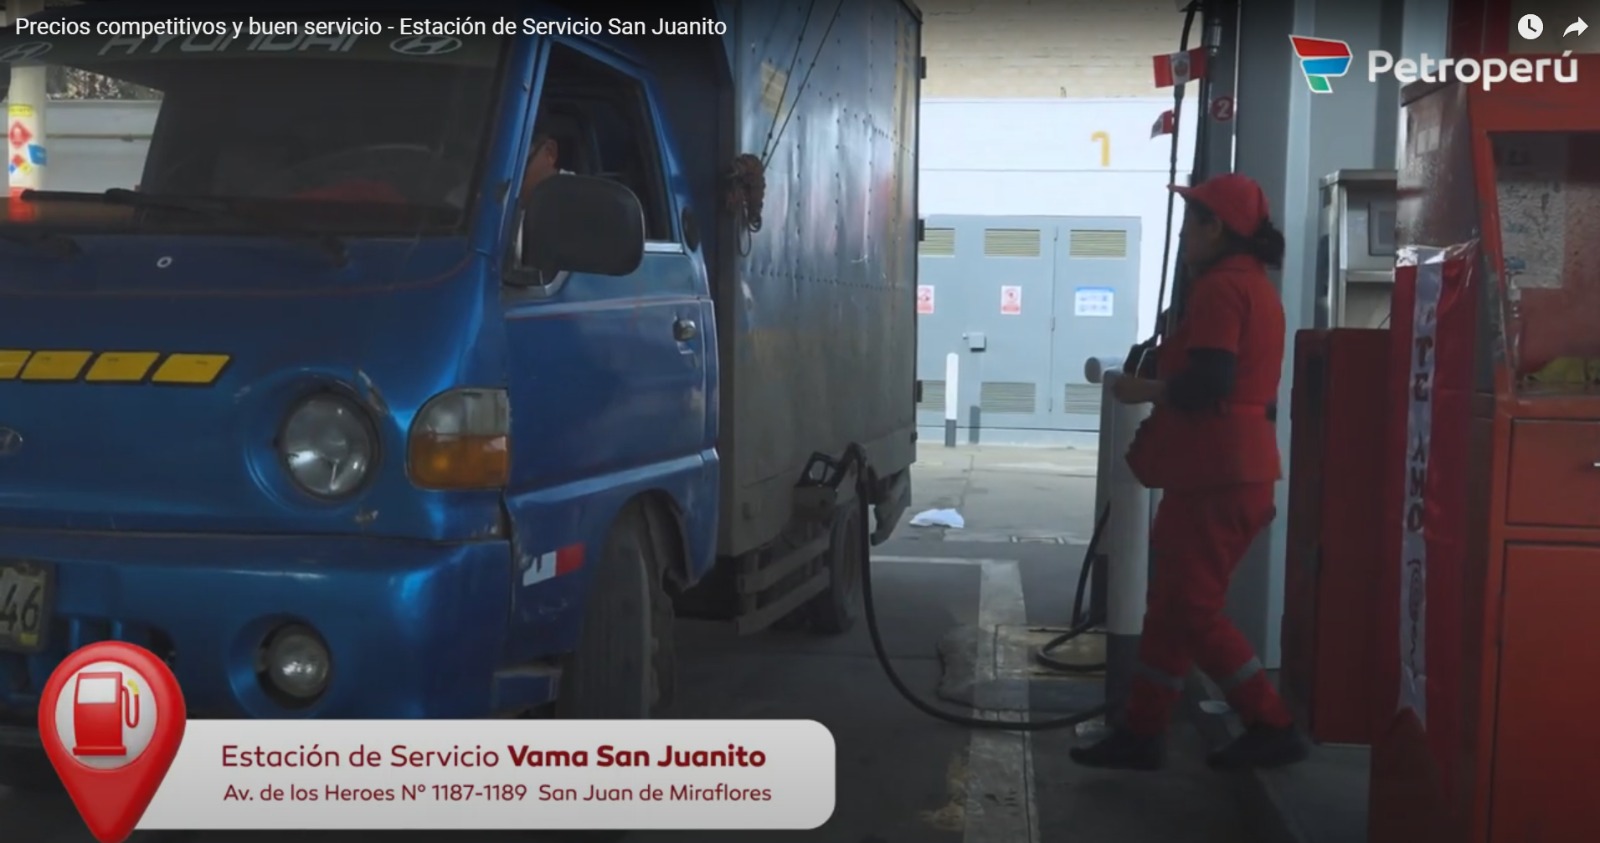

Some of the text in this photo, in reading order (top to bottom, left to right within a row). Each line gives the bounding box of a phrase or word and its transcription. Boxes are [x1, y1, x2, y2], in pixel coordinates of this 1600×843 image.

[97, 27, 362, 56] HYUNDAI
[1216, 99, 1231, 118] 2
[1091, 131, 1109, 166] 1
